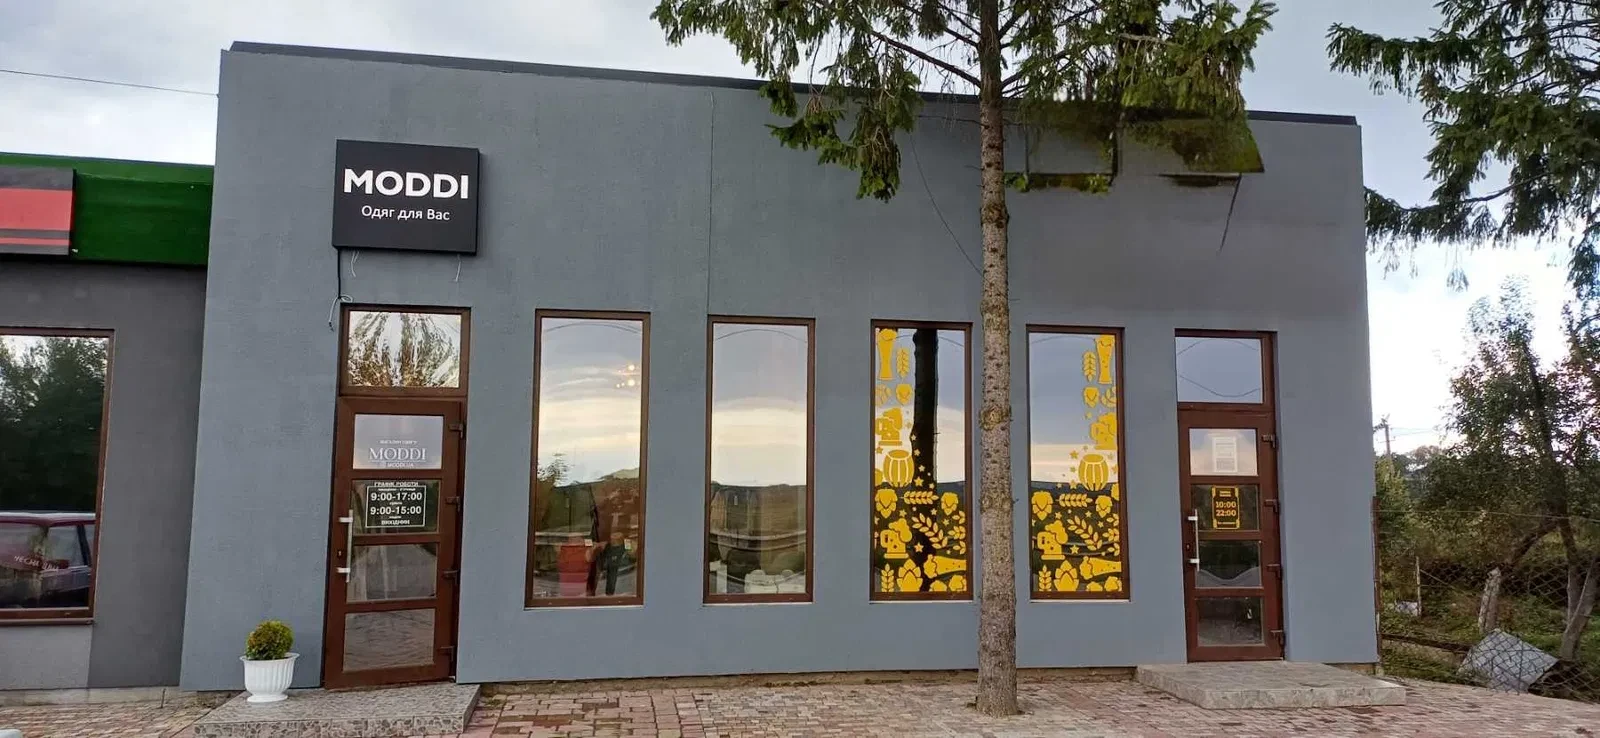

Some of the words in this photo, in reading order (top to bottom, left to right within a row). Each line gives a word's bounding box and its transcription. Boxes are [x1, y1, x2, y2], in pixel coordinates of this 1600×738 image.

[344, 168, 469, 199] MODDI
[361, 205, 395, 219] Одяг
[397, 209, 423, 221] для
[427, 208, 450, 221] Вас
[369, 447, 426, 460] MODDI
[370, 492, 423, 501] 9:00-17:00
[370, 506, 422, 515] 9:00-15:00
[1215, 509, 1237, 517] 22:00
